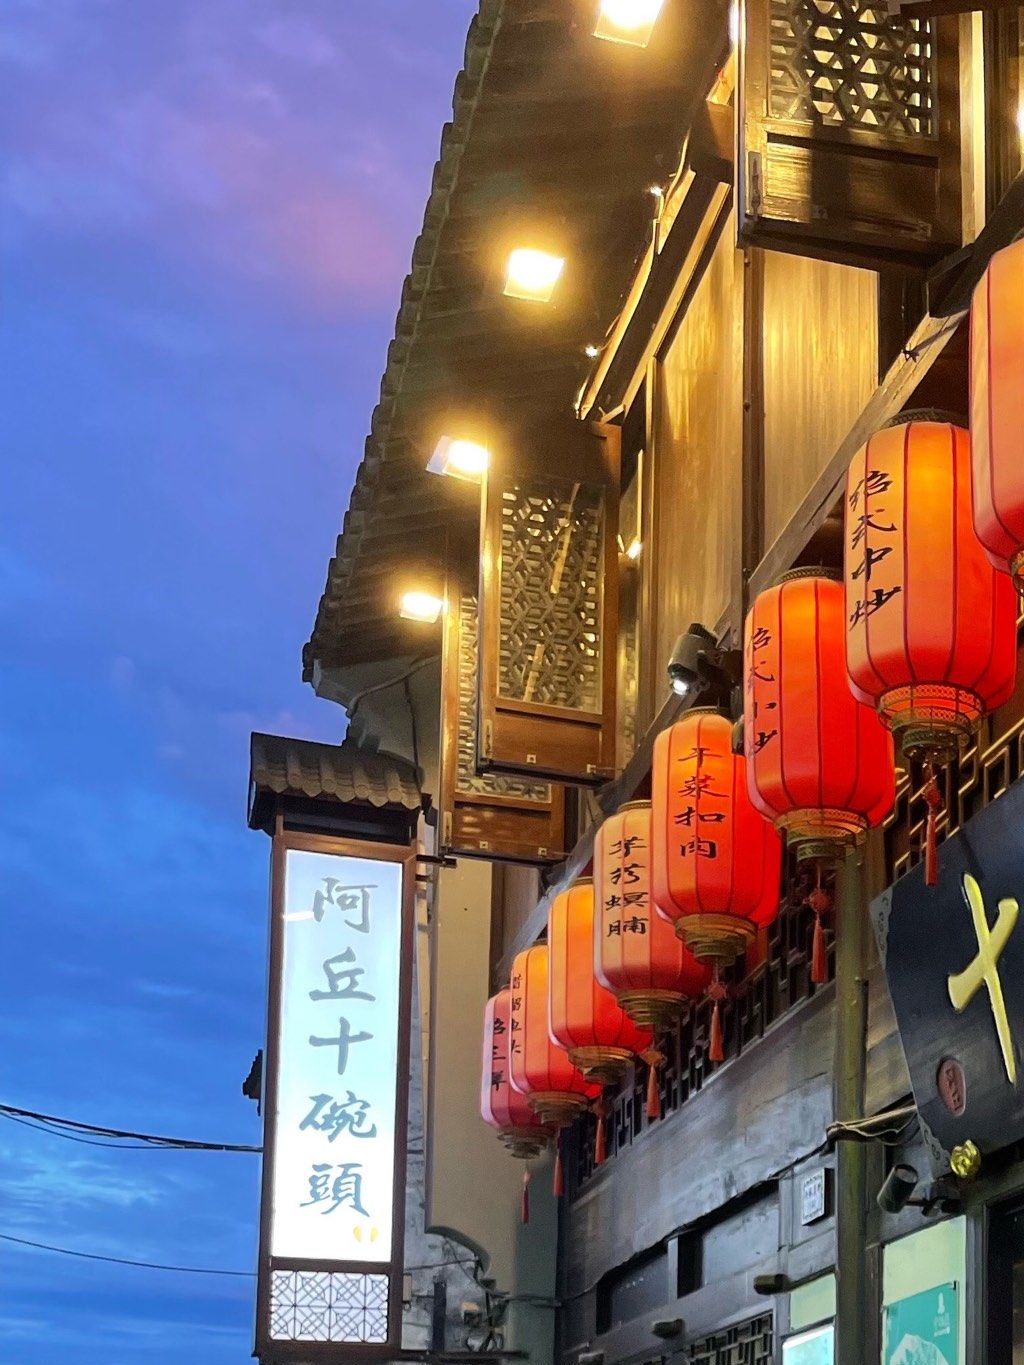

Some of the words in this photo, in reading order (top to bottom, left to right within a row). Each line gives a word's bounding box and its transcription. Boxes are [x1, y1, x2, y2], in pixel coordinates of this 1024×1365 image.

[674, 748, 730, 858] 干菜扣肉
[299, 876, 378, 1219] 阿丘十碗頭
